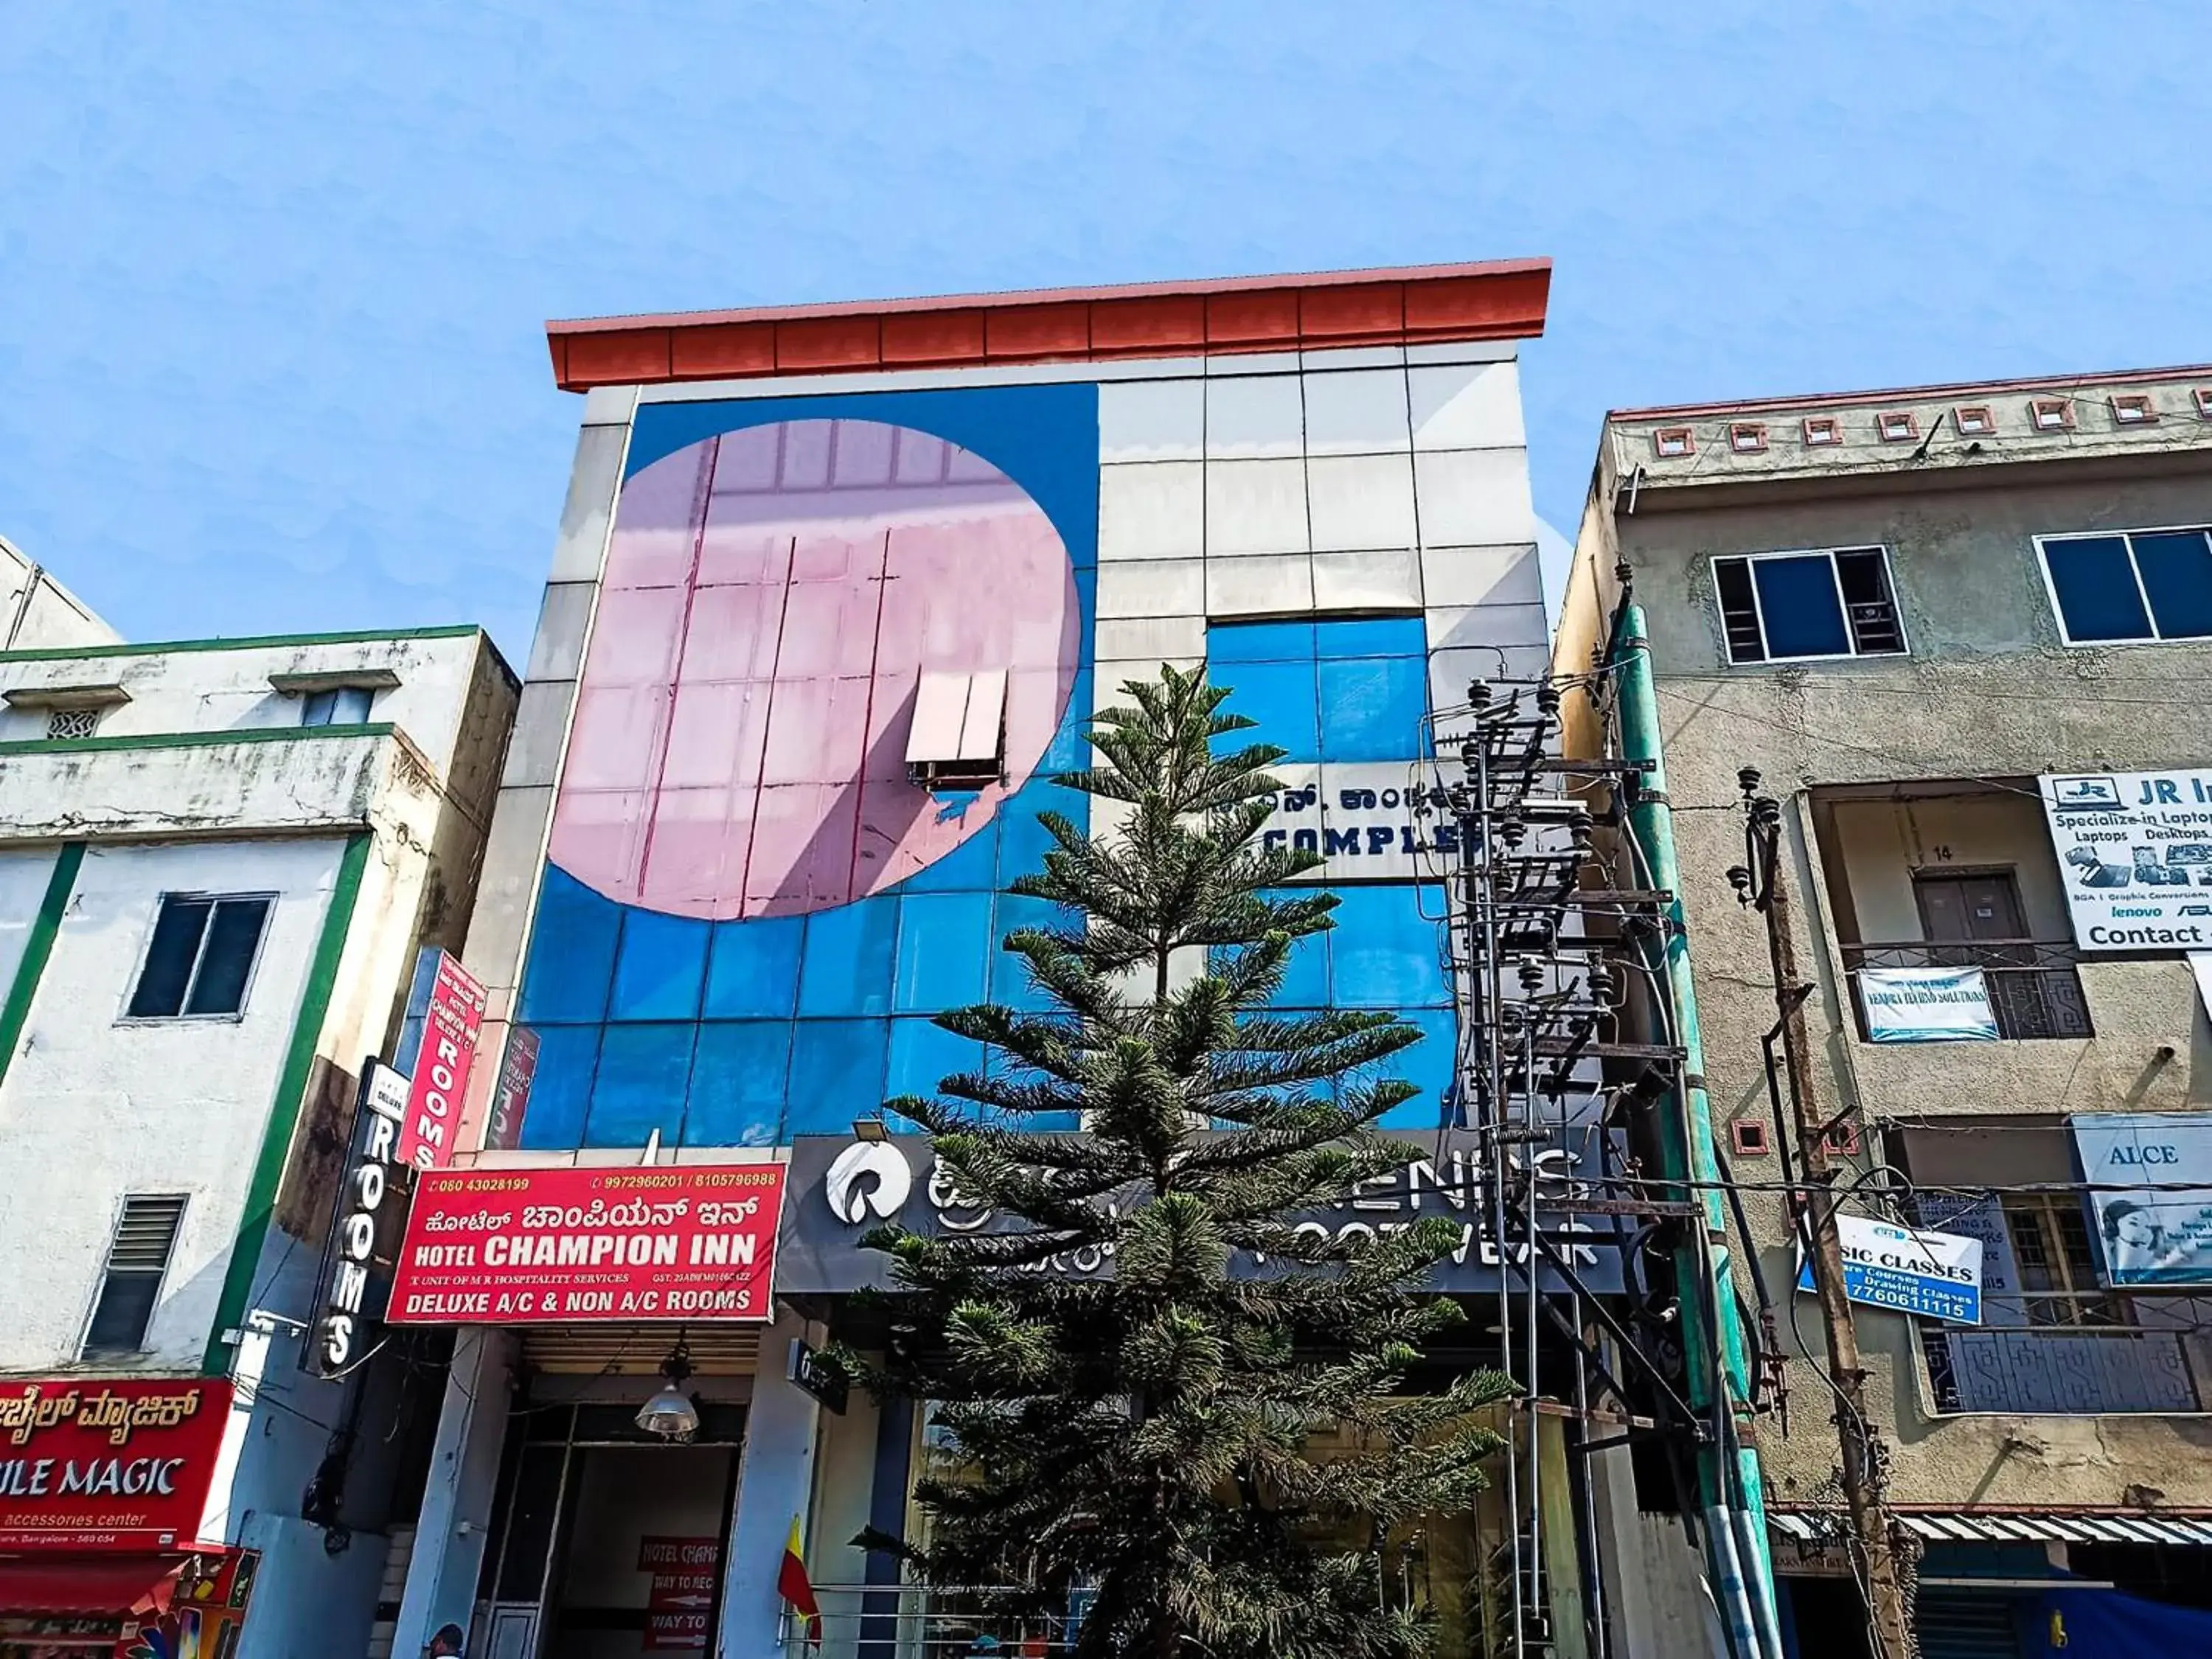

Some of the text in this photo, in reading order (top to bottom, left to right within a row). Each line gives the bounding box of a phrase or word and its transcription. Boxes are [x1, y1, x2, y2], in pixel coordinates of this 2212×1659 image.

[2139, 779, 2183, 804] JR
[2056, 812, 2137, 830] Specialize
[2142, 811, 2157, 824] in
[1264, 826, 1494, 857] COMPLE
[2075, 831, 2128, 842] Laptops
[1933, 846, 1952, 861] 14
[2112, 906, 2163, 918] lenovo
[2089, 925, 2203, 945] Contact
[414, 1036, 459, 1169] ROOMS
[425, 1196, 760, 1231] ಹೋಟೆಲ್ ಚಾಂಪಿಯನ್ ಇನ್
[329, 1113, 394, 1365] ROOMS
[414, 1234, 756, 1267] HOTEL CHAMPION INN
[1866, 1267, 1919, 1284] Courses
[1880, 1253, 1972, 1282] CLASSES
[452, 1276, 468, 1285] OF
[495, 1273, 571, 1284] HOSPITALITY
[574, 1272, 629, 1283] SERVICES
[1865, 1276, 1919, 1295] Drawing
[406, 1290, 751, 1313] DELUXE A/C & NON A/C ROOMS
[1852, 1284, 1965, 1316] 7760611115
[0, 1458, 186, 1495] ILE MAGIC
[4, 1513, 147, 1526] accessories center
[644, 1545, 678, 1562] HOTEL
[692, 1576, 714, 1589] REC
[653, 1615, 706, 1628] WAY TO
